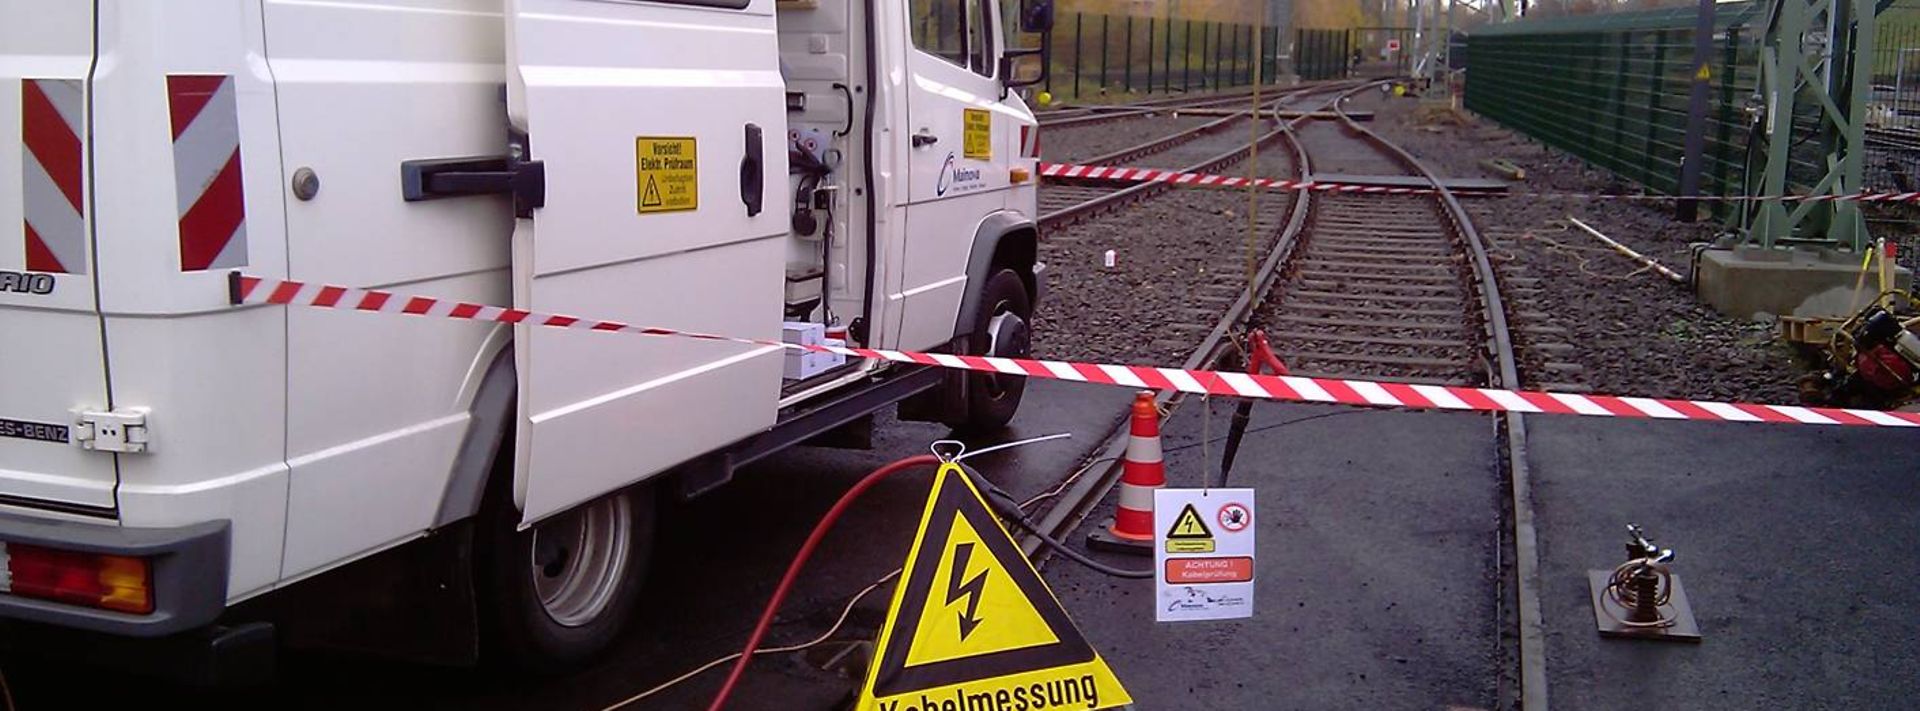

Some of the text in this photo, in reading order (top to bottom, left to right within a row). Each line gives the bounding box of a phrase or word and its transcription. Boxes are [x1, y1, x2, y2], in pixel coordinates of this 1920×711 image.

[953, 168, 979, 182] Mainova
[0, 271, 55, 294] RIO
[879, 674, 1098, 711] belmessung
